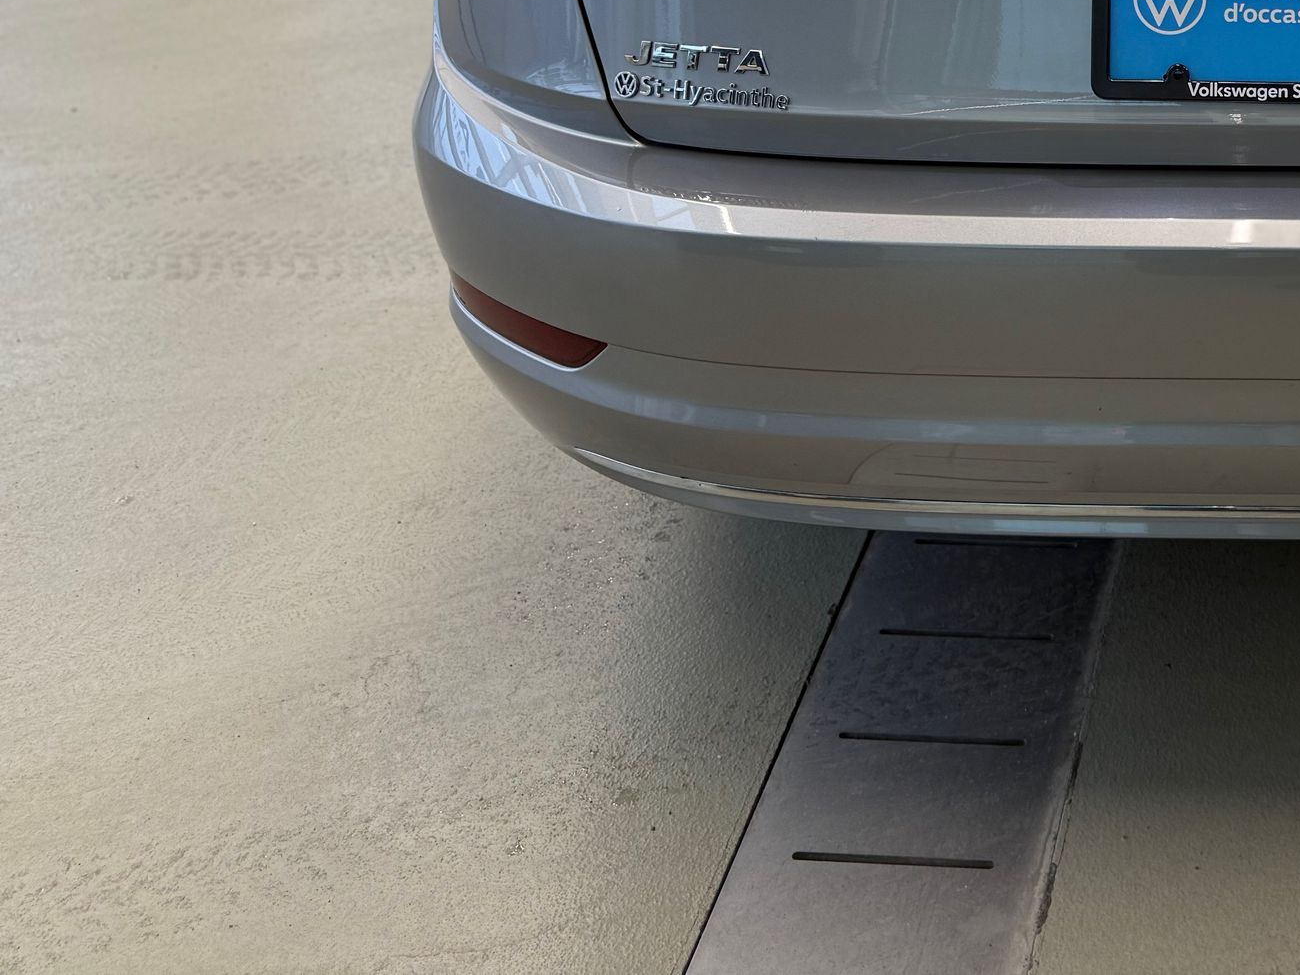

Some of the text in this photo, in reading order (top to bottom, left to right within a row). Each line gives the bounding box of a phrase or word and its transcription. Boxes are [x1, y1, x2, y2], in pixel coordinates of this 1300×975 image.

[624, 40, 770, 76] JETTA
[640, 76, 790, 110] St-Hyacinthe
[1188, 81, 1289, 101] Volkswagen
